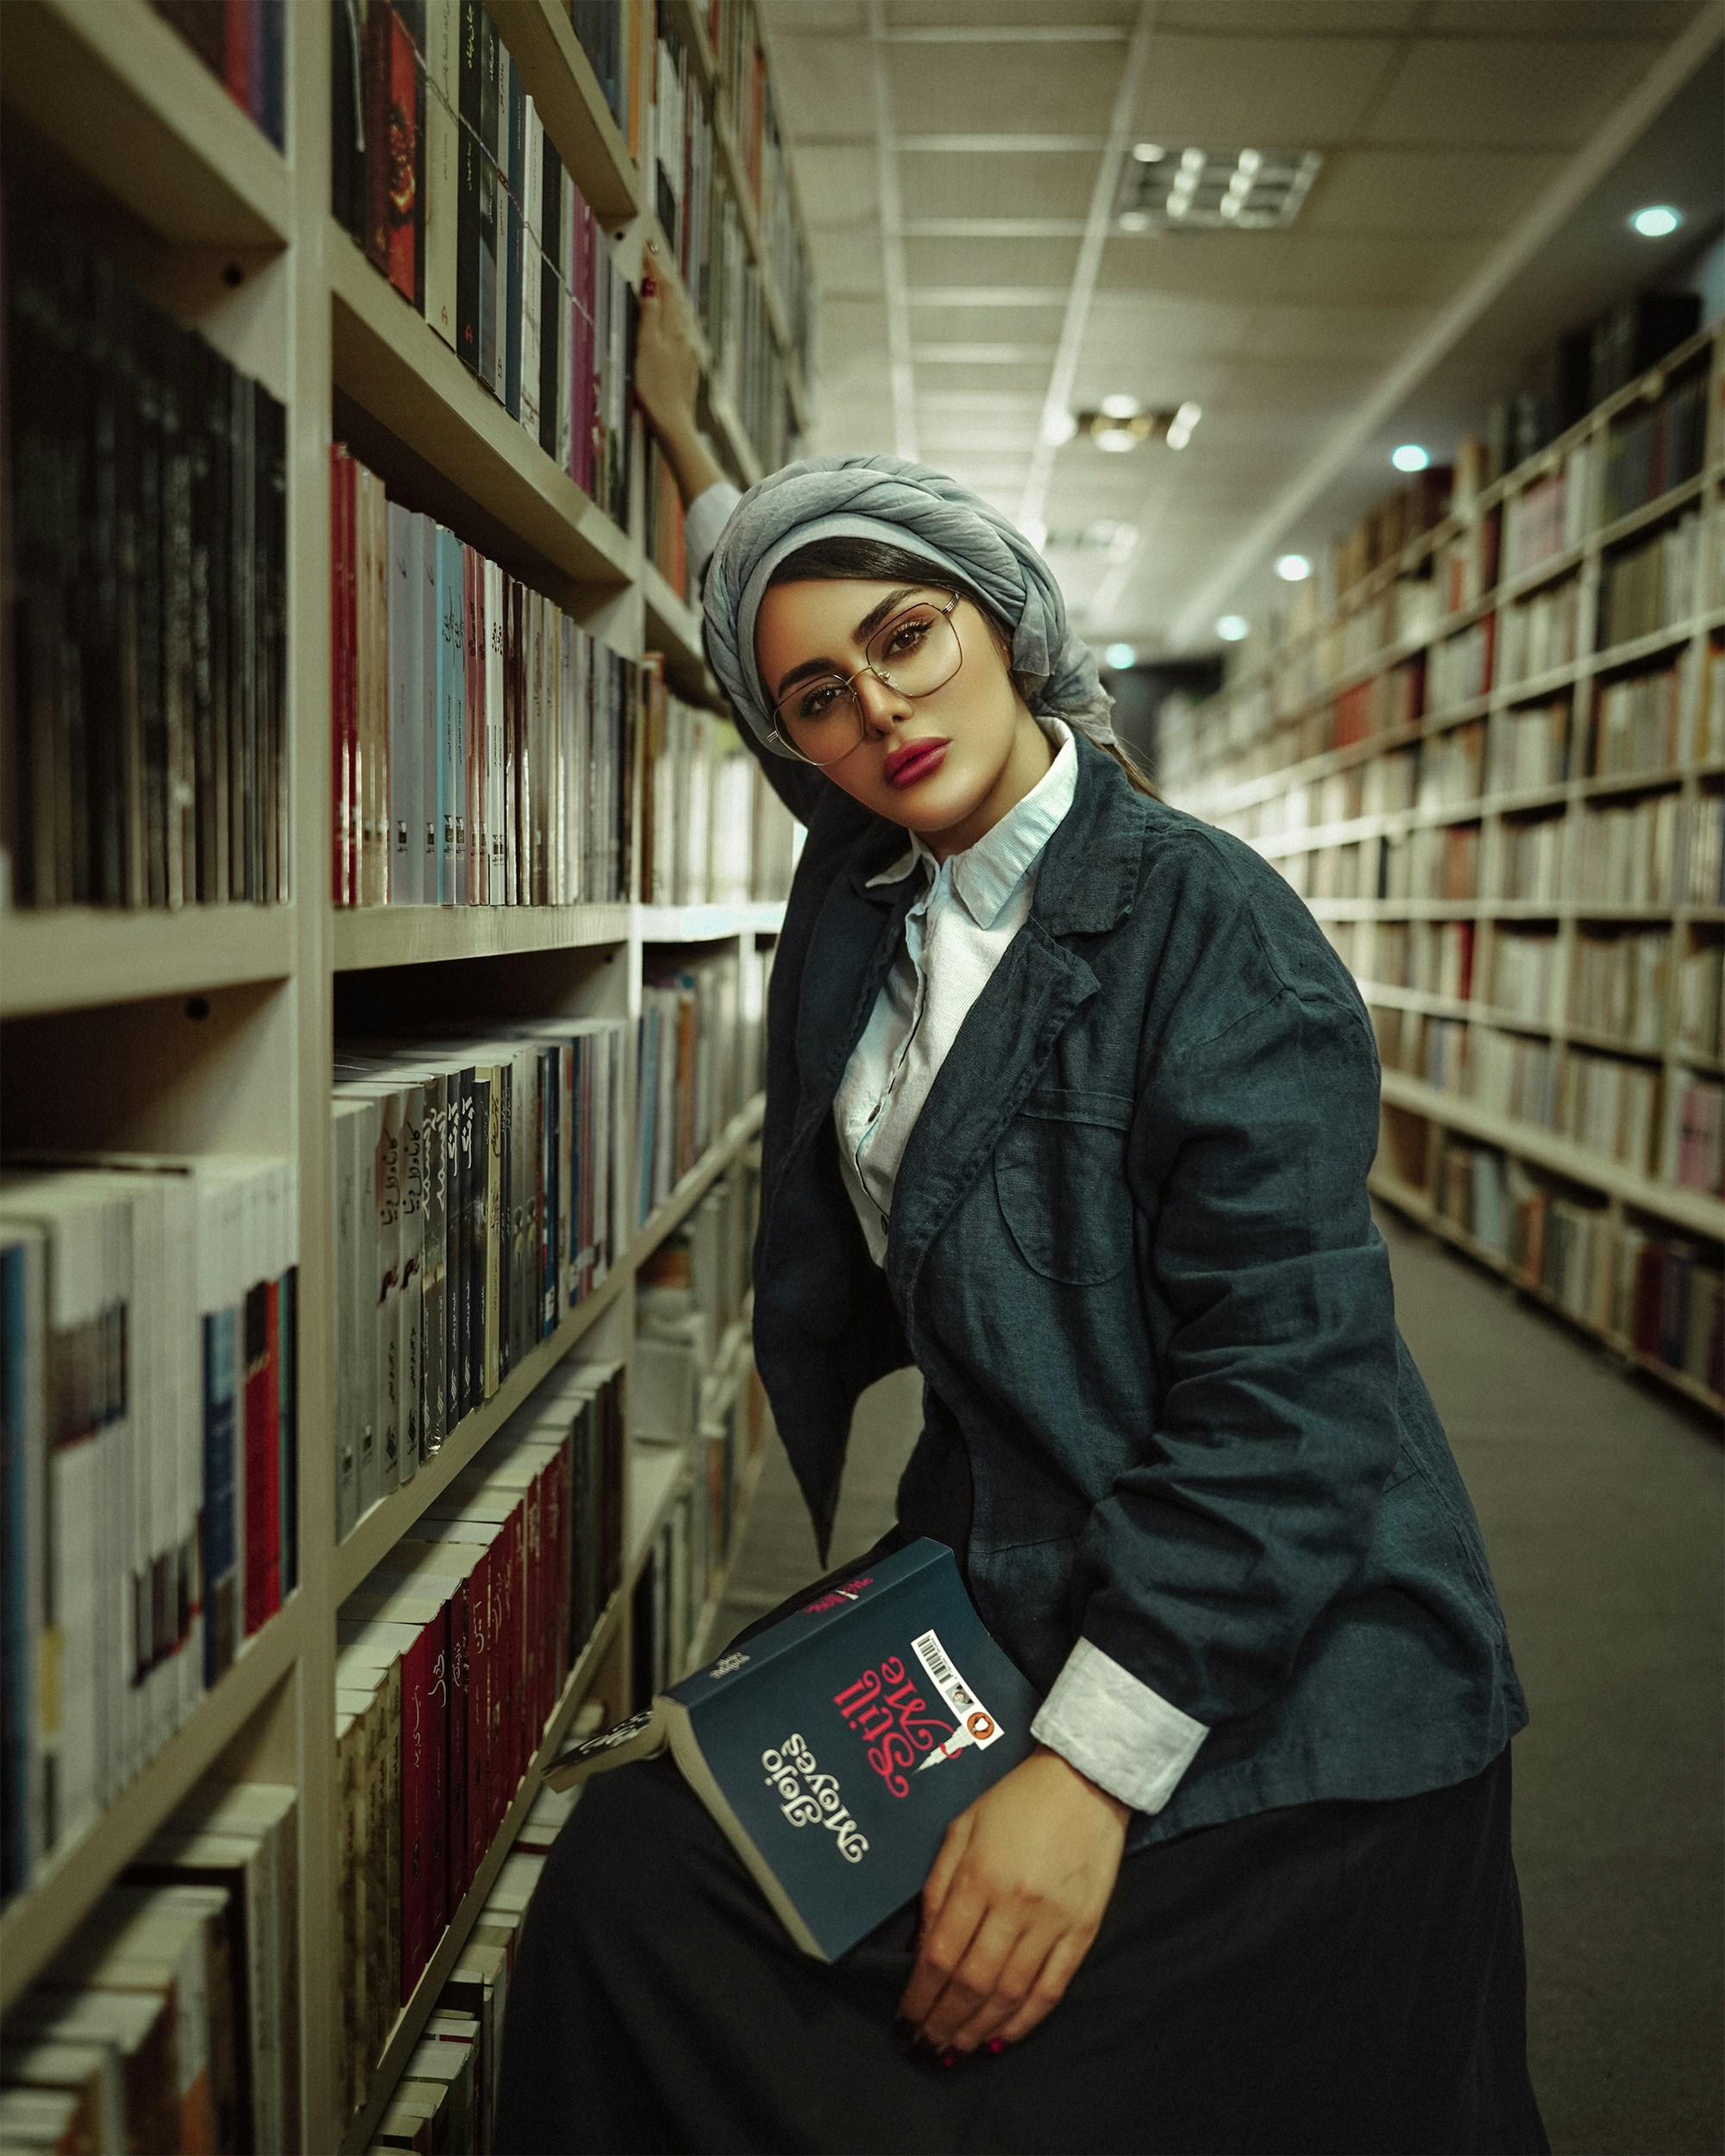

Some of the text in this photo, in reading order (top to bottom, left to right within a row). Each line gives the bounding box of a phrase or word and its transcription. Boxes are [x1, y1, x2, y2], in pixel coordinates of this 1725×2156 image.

[404, 1121, 422, 1196] کارناوال
[448, 1101, 460, 1176] آونگ
[461, 1096, 475, 1169] آونگ
[834, 1669, 914, 1798] Still
[881, 1656, 963, 1761] Me
[761, 1748, 822, 1828] Jojo
[780, 1733, 870, 1864] Moyes
